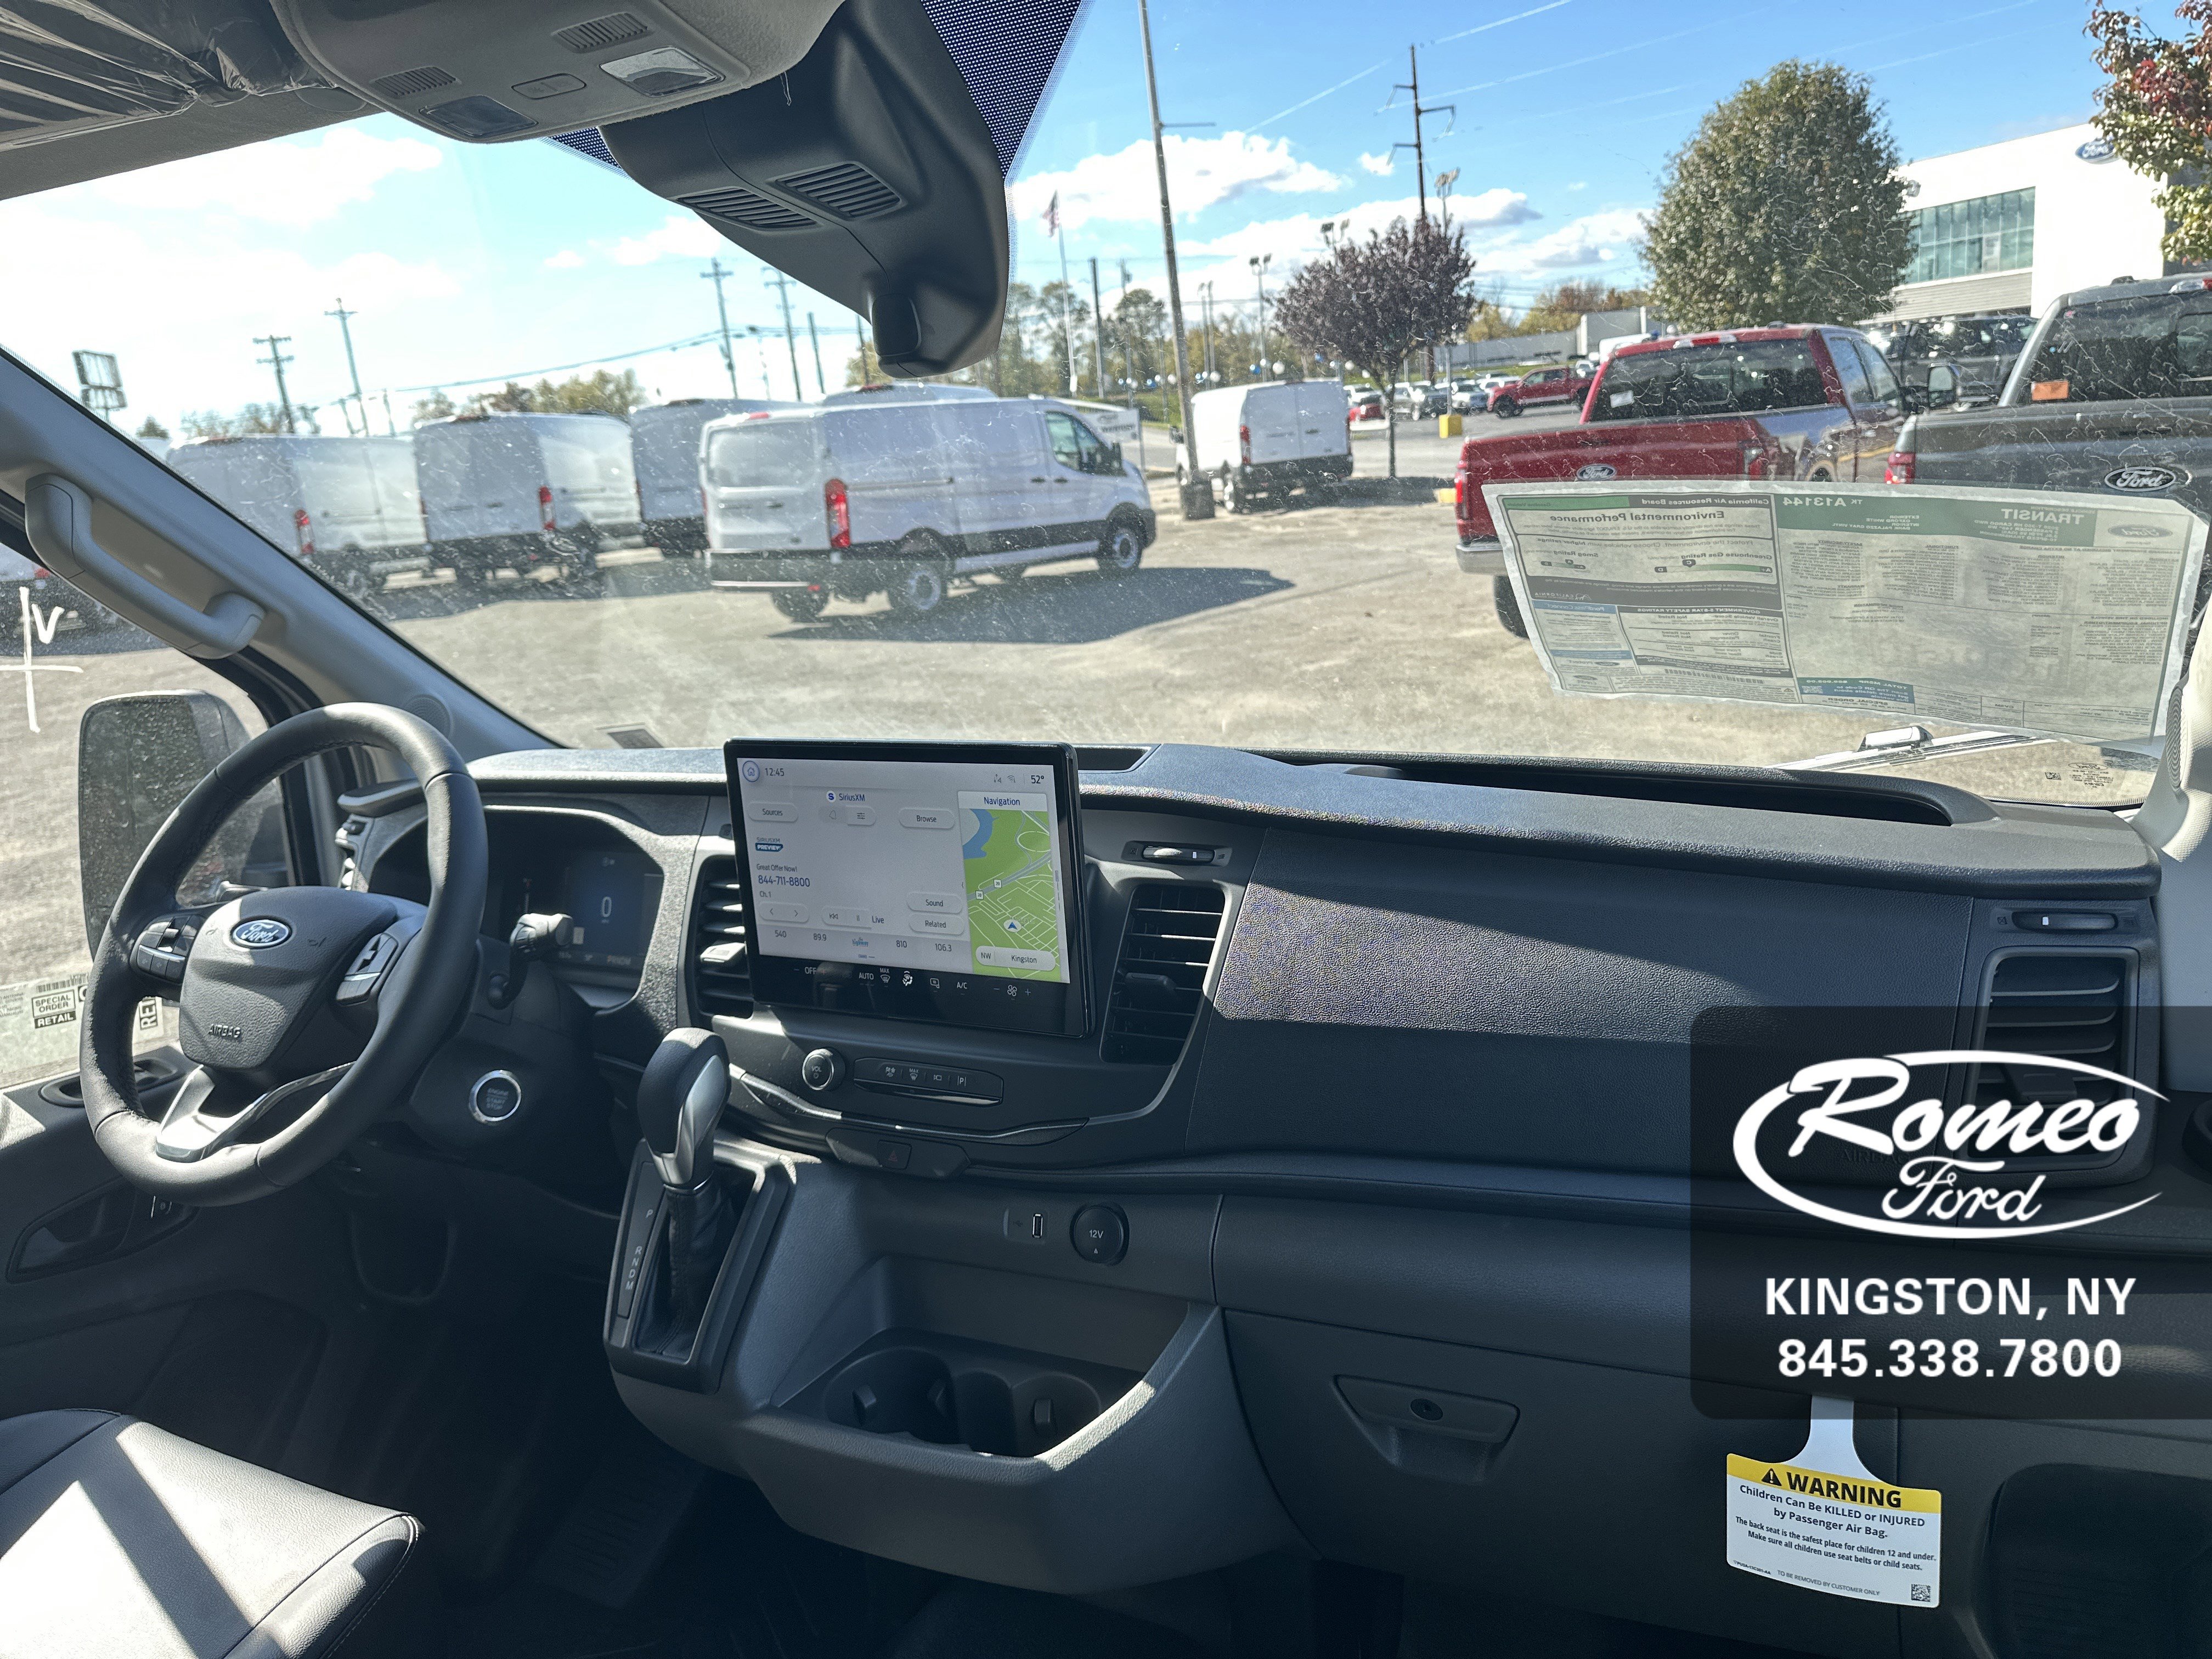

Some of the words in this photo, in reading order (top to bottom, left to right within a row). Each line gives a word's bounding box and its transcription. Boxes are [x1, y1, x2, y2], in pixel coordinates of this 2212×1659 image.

[1582, 466, 1610, 479] Ford
[2115, 469, 2164, 488] Ford
[765, 768, 785, 776] 12:45
[1031, 775, 1045, 783] 52°
[839, 793, 865, 802] SiriusXM
[984, 797, 1020, 806] Navigation
[758, 876, 810, 887] 844-711-8800
[600, 896, 612, 918] 0
[241, 922, 279, 943] Ford
[1011, 955, 1037, 963] Kingston
[35, 994, 71, 1007] SPECIAL
[39, 1001, 69, 1013] ORDER
[38, 1014, 74, 1027] RETAIL
[208, 1023, 241, 1039] AIRBAG
[646, 1209, 653, 1218] P
[1089, 1229, 1104, 1239] 12V
[635, 1245, 642, 1255] R
[631, 1257, 639, 1266] N
[628, 1269, 636, 1279] D
[1786, 1471, 1902, 1508] WARNING
[1740, 1485, 1783, 1504] Children
[1786, 1496, 1805, 1509] Can
[1808, 1500, 1822, 1512] Be
[1825, 1505, 1861, 1520] KILLED
[1865, 1513, 1876, 1521] or
[1879, 1513, 1925, 1527] INJURED
[1774, 1508, 1786, 1520] by
[1789, 1512, 1843, 1532] Passenger
[1846, 1523, 1861, 1534] Air
[1865, 1526, 1888, 1539] Bag.
[1735, 1516, 1748, 1526] The
[1749, 1519, 1764, 1531] back
[1766, 1524, 1780, 1534] seat
[1781, 1528, 1787, 1537] is
[1789, 1530, 1801, 1541] the
[1802, 1534, 1823, 1545] safest
[1824, 1539, 1843, 1551] place
[1844, 1542, 1855, 1551] for
[1857, 1544, 1885, 1556] children
[1887, 1549, 1896, 1558] 12
[1898, 1550, 1911, 1559] and
[1913, 1552, 1937, 1561] under.
[1748, 1530, 1767, 1543] Make
[1768, 1537, 1783, 1547] sure
[1784, 1539, 1792, 1549] all
[1794, 1542, 1822, 1555] children
[1824, 1550, 1836, 1559] use
[1838, 1553, 1852, 1562] seat
[1854, 1555, 1872, 1566] belts
[1874, 1558, 1881, 1566] or
[1883, 1558, 1900, 1568] child
[1901, 1561, 1923, 1571] seats.
[1795, 1573, 1822, 1585] REMOVED
[1831, 1582, 1863, 1594] CUSTOMER
